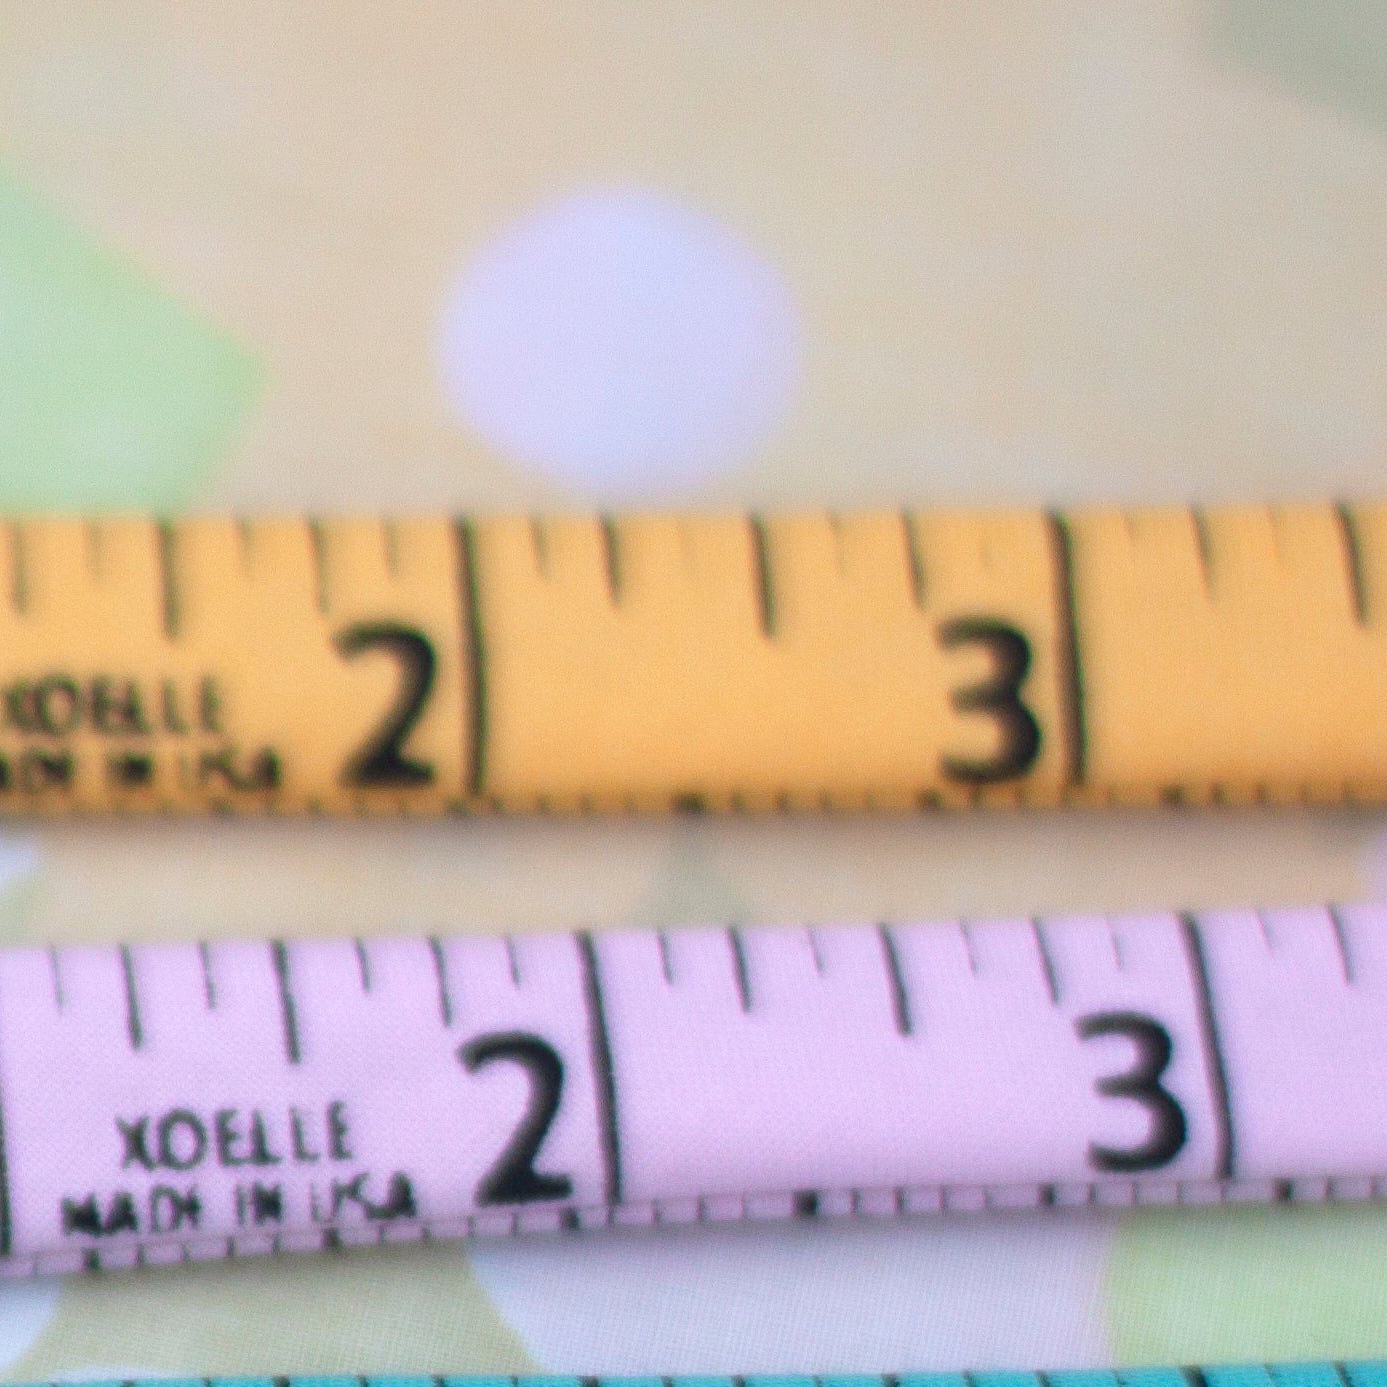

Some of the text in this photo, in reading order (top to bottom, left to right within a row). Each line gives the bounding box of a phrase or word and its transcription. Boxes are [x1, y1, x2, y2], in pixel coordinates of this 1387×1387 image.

[335, 620, 438, 787] 2
[938, 615, 1041, 786] 3
[115, 1100, 354, 1171] XOELLE
[458, 1030, 573, 1202] 2
[1074, 1010, 1189, 1173] 3
[236, 1181, 282, 1224] IN
